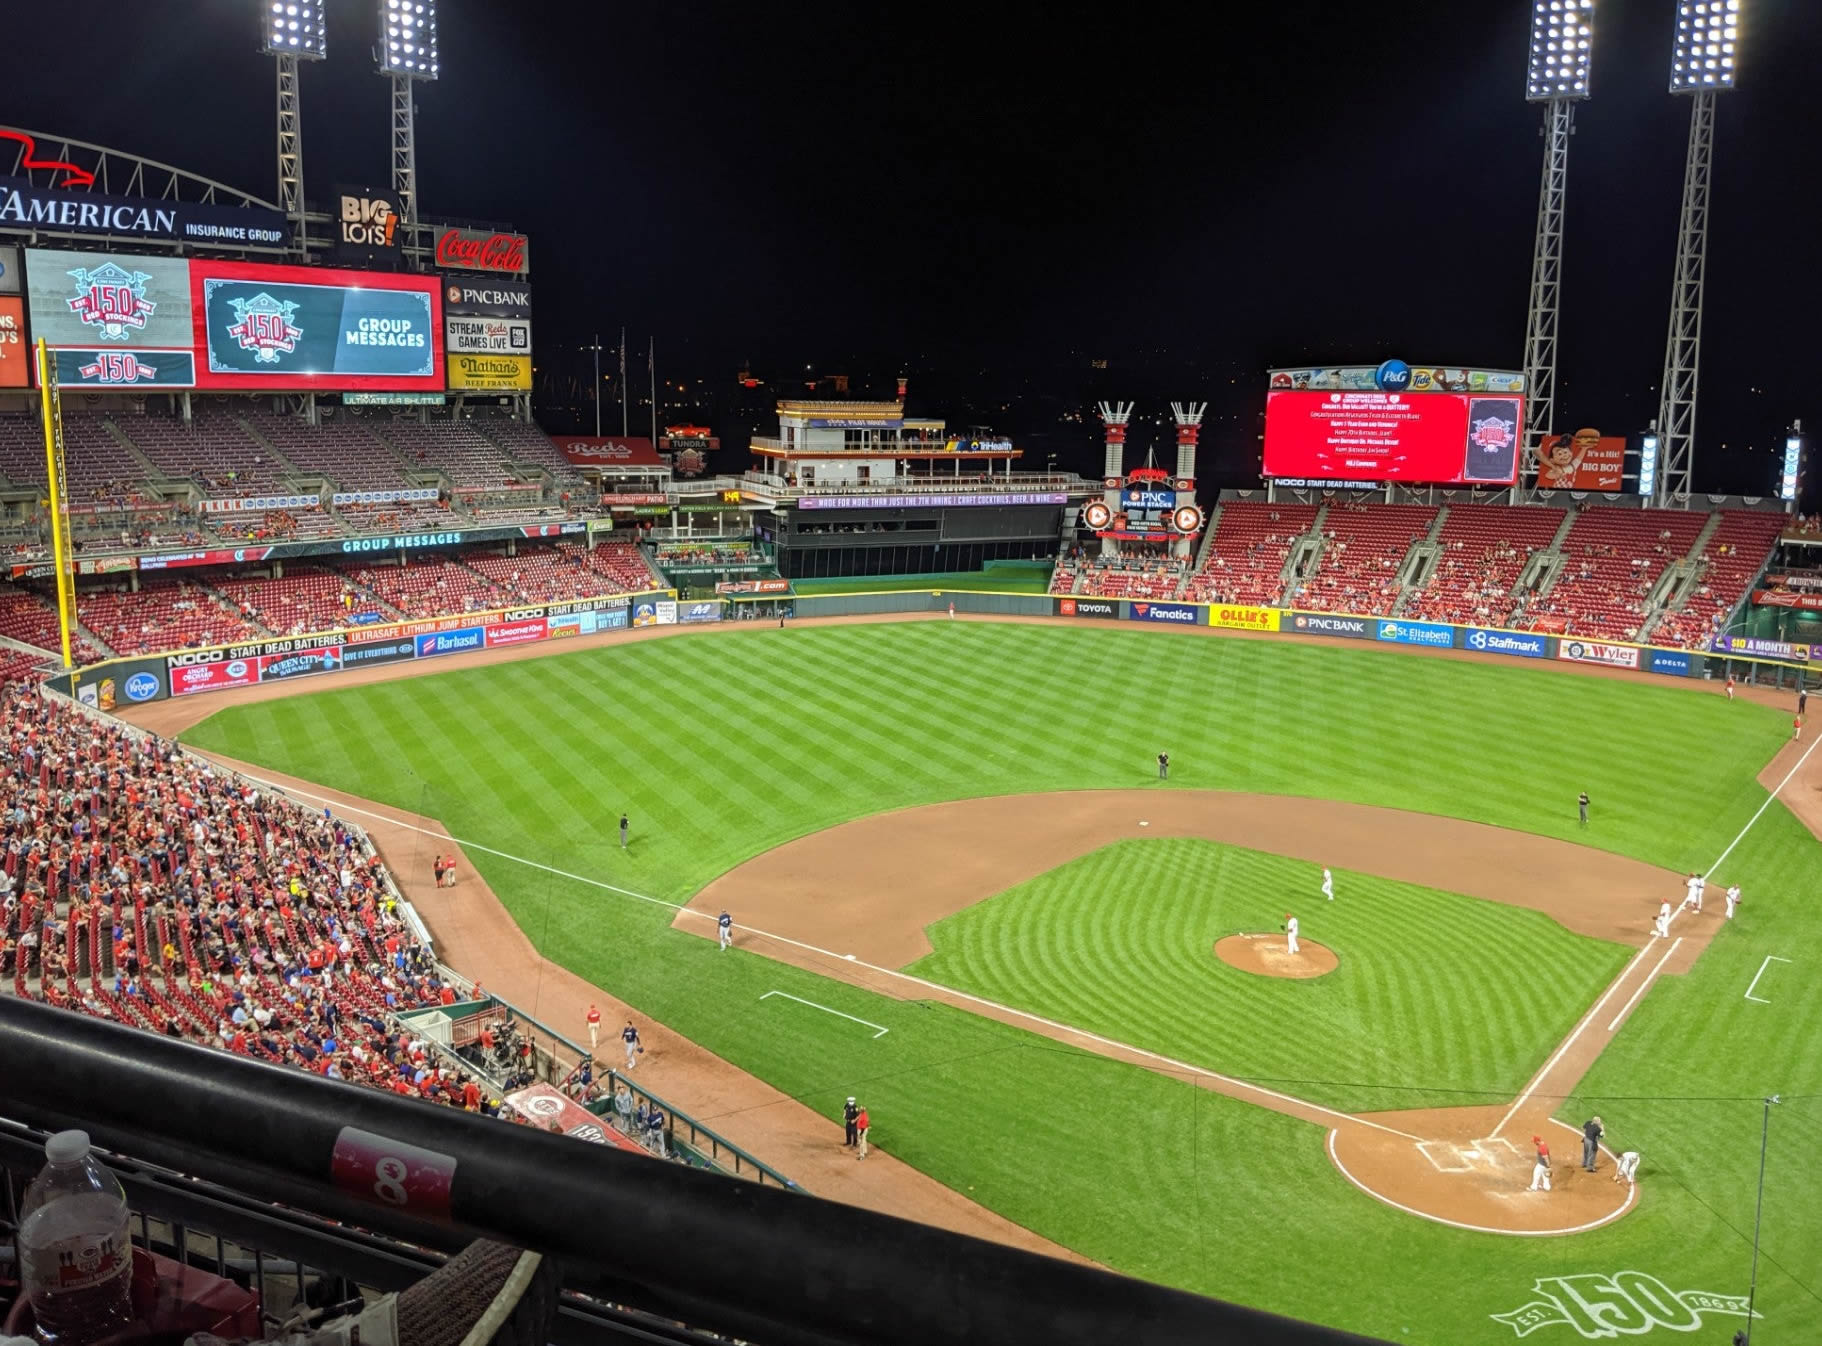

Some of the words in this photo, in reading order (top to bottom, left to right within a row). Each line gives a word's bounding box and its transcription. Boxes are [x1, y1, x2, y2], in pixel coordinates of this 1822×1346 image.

[0, 190, 177, 233] AMERICAN
[186, 223, 246, 239] INSURANCE
[248, 228, 282, 242] GROUP
[341, 195, 392, 225] BIG
[343, 213, 398, 247] LOTS!
[90, 286, 132, 315] 150
[247, 314, 284, 338] 150
[358, 318, 411, 333] GROUP
[450, 322, 484, 335] STREAM
[485, 323, 508, 336] Reds
[346, 331, 425, 347] MESSAGES
[458, 336, 488, 349] GAMES
[490, 338, 507, 349] LIVE
[98, 355, 136, 381] 150
[460, 357, 520, 375] Nathan's
[1383, 371, 1408, 383] P&G
[1412, 375, 1430, 385] Tide
[344, 397, 386, 405] ULTIMATE
[404, 397, 442, 405] SHUTTLE
[568, 442, 633, 456] Reds
[672, 440, 707, 448] TUNDRA
[980, 441, 1013, 450] TriHealth
[1582, 463, 1599, 471] BIG
[1600, 464, 1619, 472] BOY
[1307, 480, 1325, 488] START
[819, 498, 837, 507] MADE
[853, 498, 870, 507] MORE
[871, 498, 887, 506] THAN
[888, 497, 904, 506] JUST
[905, 497, 917, 506] THE
[1141, 493, 1166, 502] PNC
[343, 537, 389, 552] GROUP
[395, 533, 461, 549] MESSAGES
[504, 609, 545, 622] NOCO
[548, 605, 571, 616] START
[573, 602, 592, 613] DEAD
[1078, 604, 1111, 613] TOYOTA
[1150, 607, 1193, 620] Fanatics
[352, 627, 399, 642] ULTRASAFE
[403, 623, 436, 635] LITHIUM
[437, 620, 458, 631] JUMP
[1247, 622, 1270, 630] OUTLET
[437, 633, 478, 650] Barbasol
[1409, 628, 1450, 640] Elizabeth
[230, 644, 262, 659] START
[265, 641, 292, 656] DEAD
[295, 635, 347, 651] BATTERIES.
[1488, 636, 1540, 652] Staffmark
[1731, 638, 1746, 648] $10
[1747, 641, 1754, 649] A
[1756, 640, 1790, 654] MONTH
[168, 650, 224, 667] NOCO
[344, 653, 357, 661] GIVE
[358, 651, 363, 660] IT
[364, 646, 397, 659] EVERYTHING
[1592, 645, 1636, 661] Wyler
[268, 657, 299, 674] QUEEN
[300, 654, 321, 666] CITY
[182, 671, 214, 681] ORCHARD
[129, 679, 156, 697] Kroger
[374, 1157, 408, 1205] 8
[1533, 1271, 1702, 1338] 150
[1689, 1297, 1739, 1311] 1869
[1516, 1309, 1552, 1327] EST.
